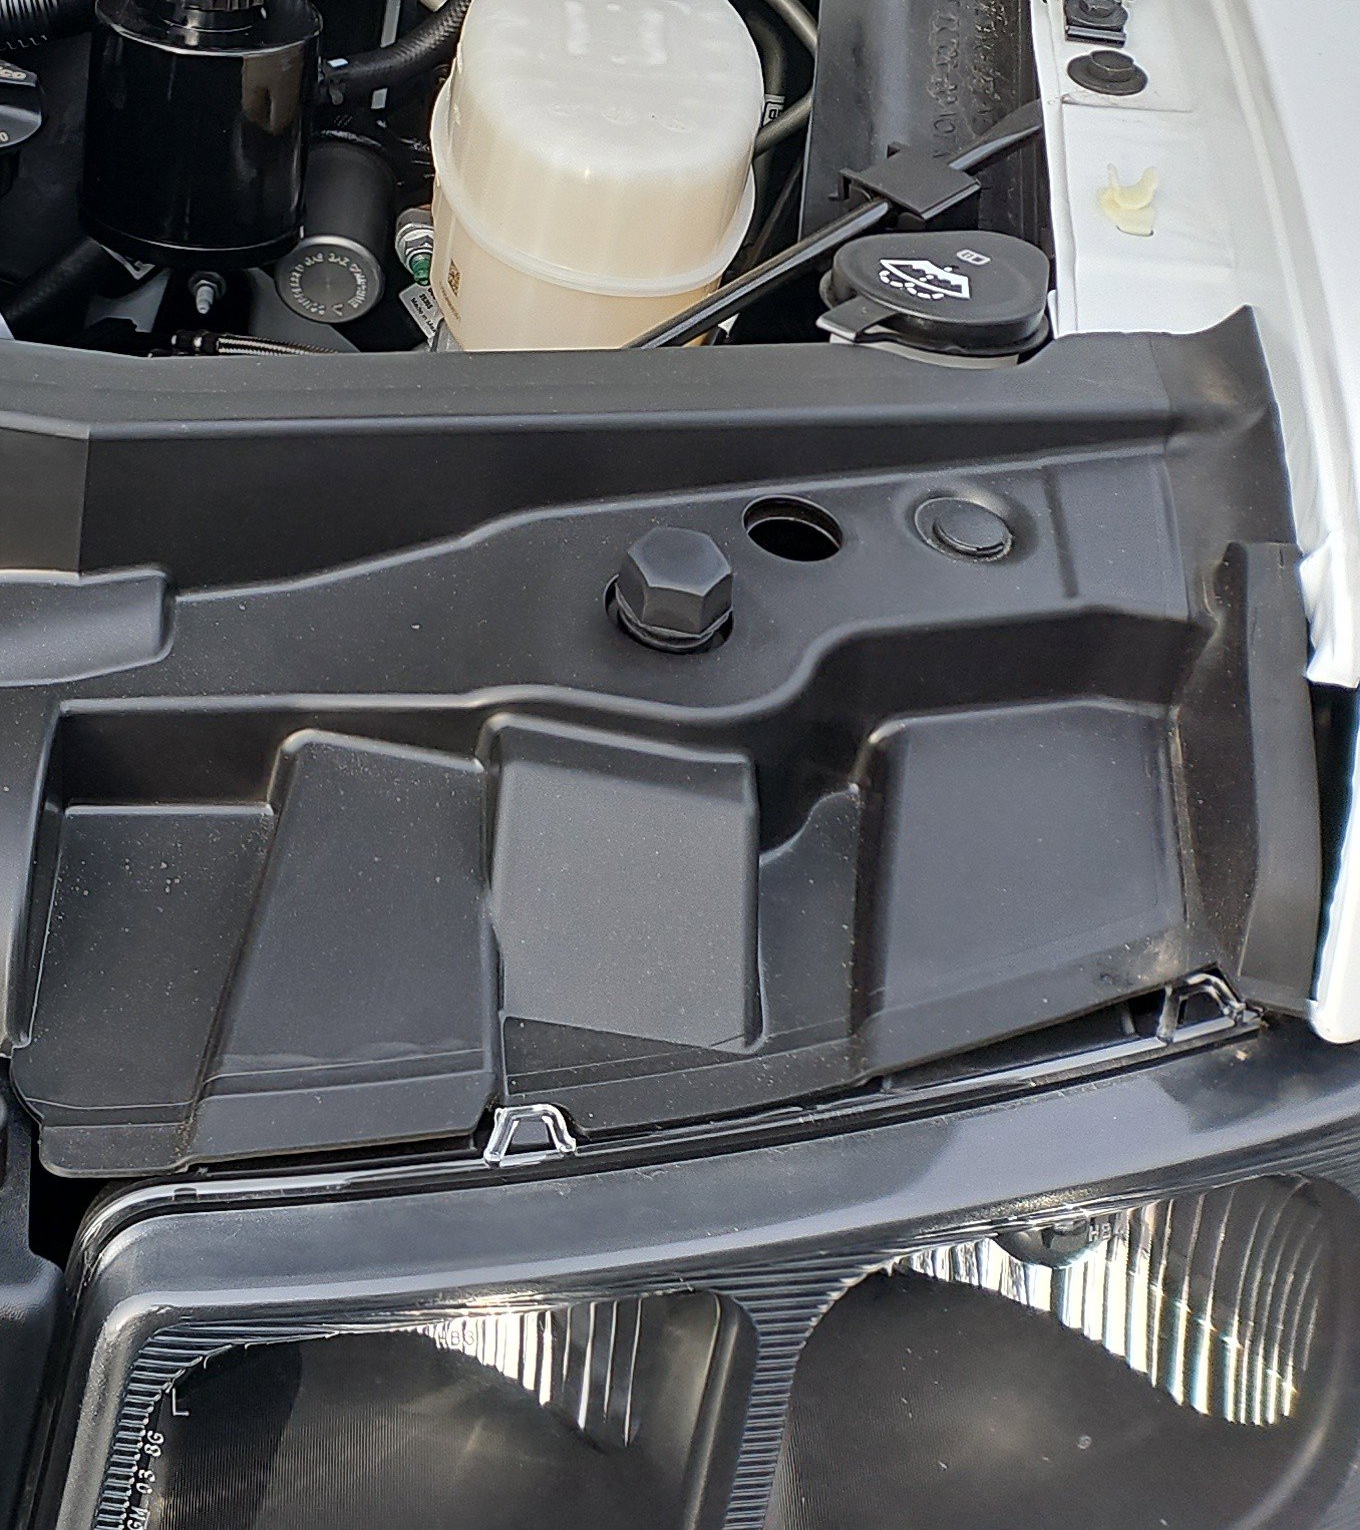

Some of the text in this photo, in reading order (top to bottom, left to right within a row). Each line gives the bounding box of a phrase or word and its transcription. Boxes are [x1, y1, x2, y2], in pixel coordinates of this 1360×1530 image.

[438, 1330, 475, 1347] HB3
[171, 1387, 190, 1416] L
[136, 1469, 156, 1494] 03
